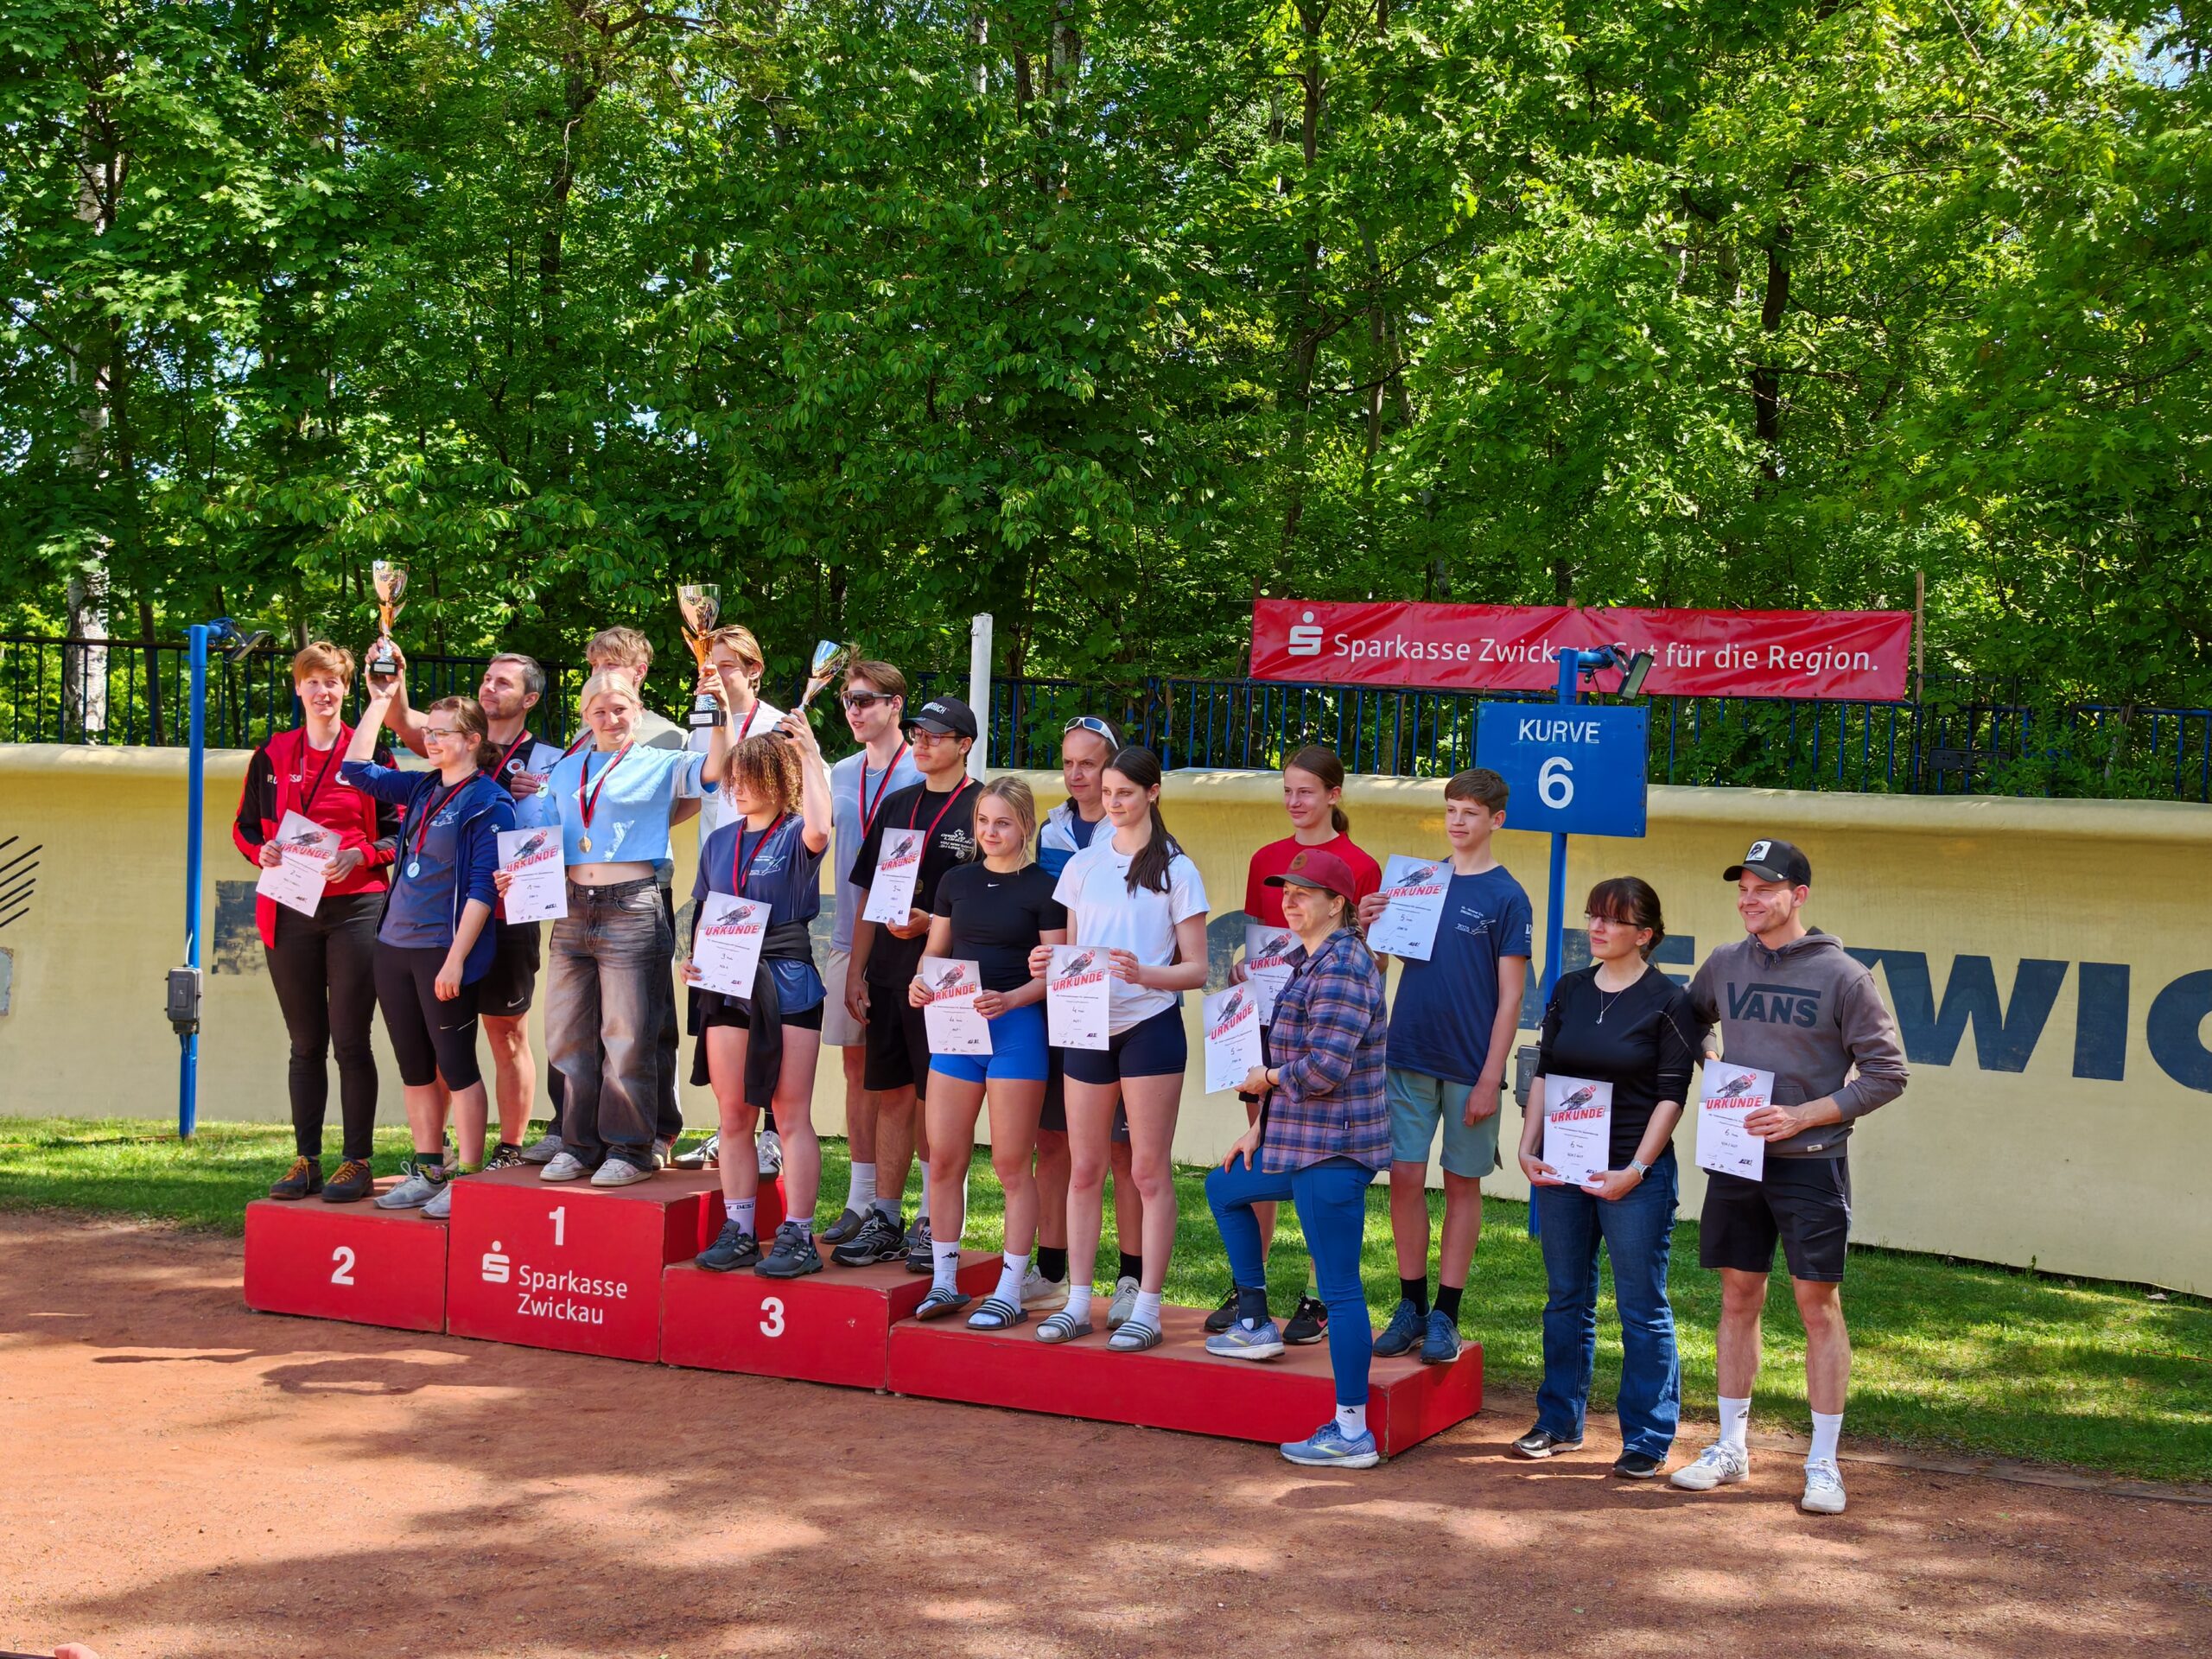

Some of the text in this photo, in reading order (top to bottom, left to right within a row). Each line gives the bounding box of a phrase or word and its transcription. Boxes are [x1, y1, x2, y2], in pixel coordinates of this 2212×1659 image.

[1333, 633, 1471, 663] Sparkasse
[1478, 638, 1590, 664] Zwick
[1666, 641, 1706, 668] für
[1714, 642, 1758, 670] die
[1768, 644, 1879, 677] Region.
[1518, 718, 1601, 744] KURVE
[1538, 756, 1574, 810] 6
[506, 848, 557, 872] URKUNDE
[880, 854, 917, 871] URKUNDE
[705, 925, 760, 936] URKUNDE
[1053, 970, 1103, 991] URKUNDE
[1726, 982, 1821, 1028] VANS
[1211, 1005, 1253, 1040] URKUNDE
[1551, 1107, 1605, 1122] URKUNDE
[1707, 1096, 1763, 1109] URKUNDE
[549, 1206, 565, 1246] 1
[331, 1246, 355, 1286] 2
[518, 1265, 628, 1300] Sparkasse
[518, 1293, 604, 1325] Zwickau
[760, 1296, 785, 1338] 3
